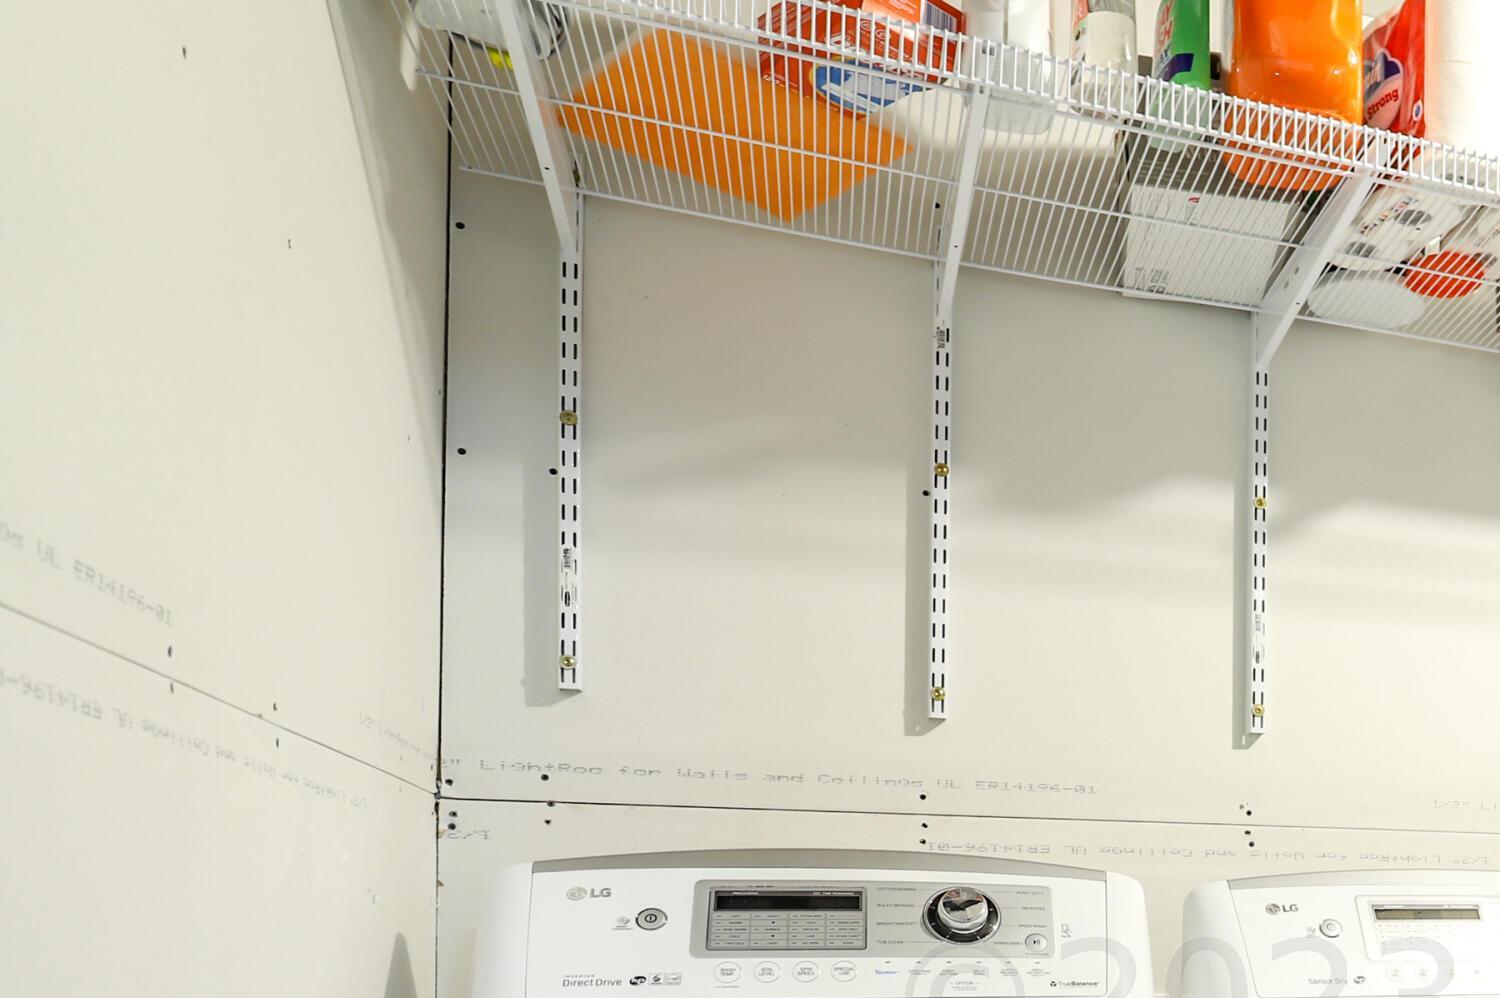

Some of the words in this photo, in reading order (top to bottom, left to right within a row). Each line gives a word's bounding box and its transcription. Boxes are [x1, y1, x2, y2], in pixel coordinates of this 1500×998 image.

[1368, 88, 1399, 120] Strong
[935, 777, 962, 790] UL
[589, 887, 612, 898] LG
[1282, 904, 1299, 913] LG
[562, 978, 595, 988] Direct
[595, 978, 622, 987] Drive
